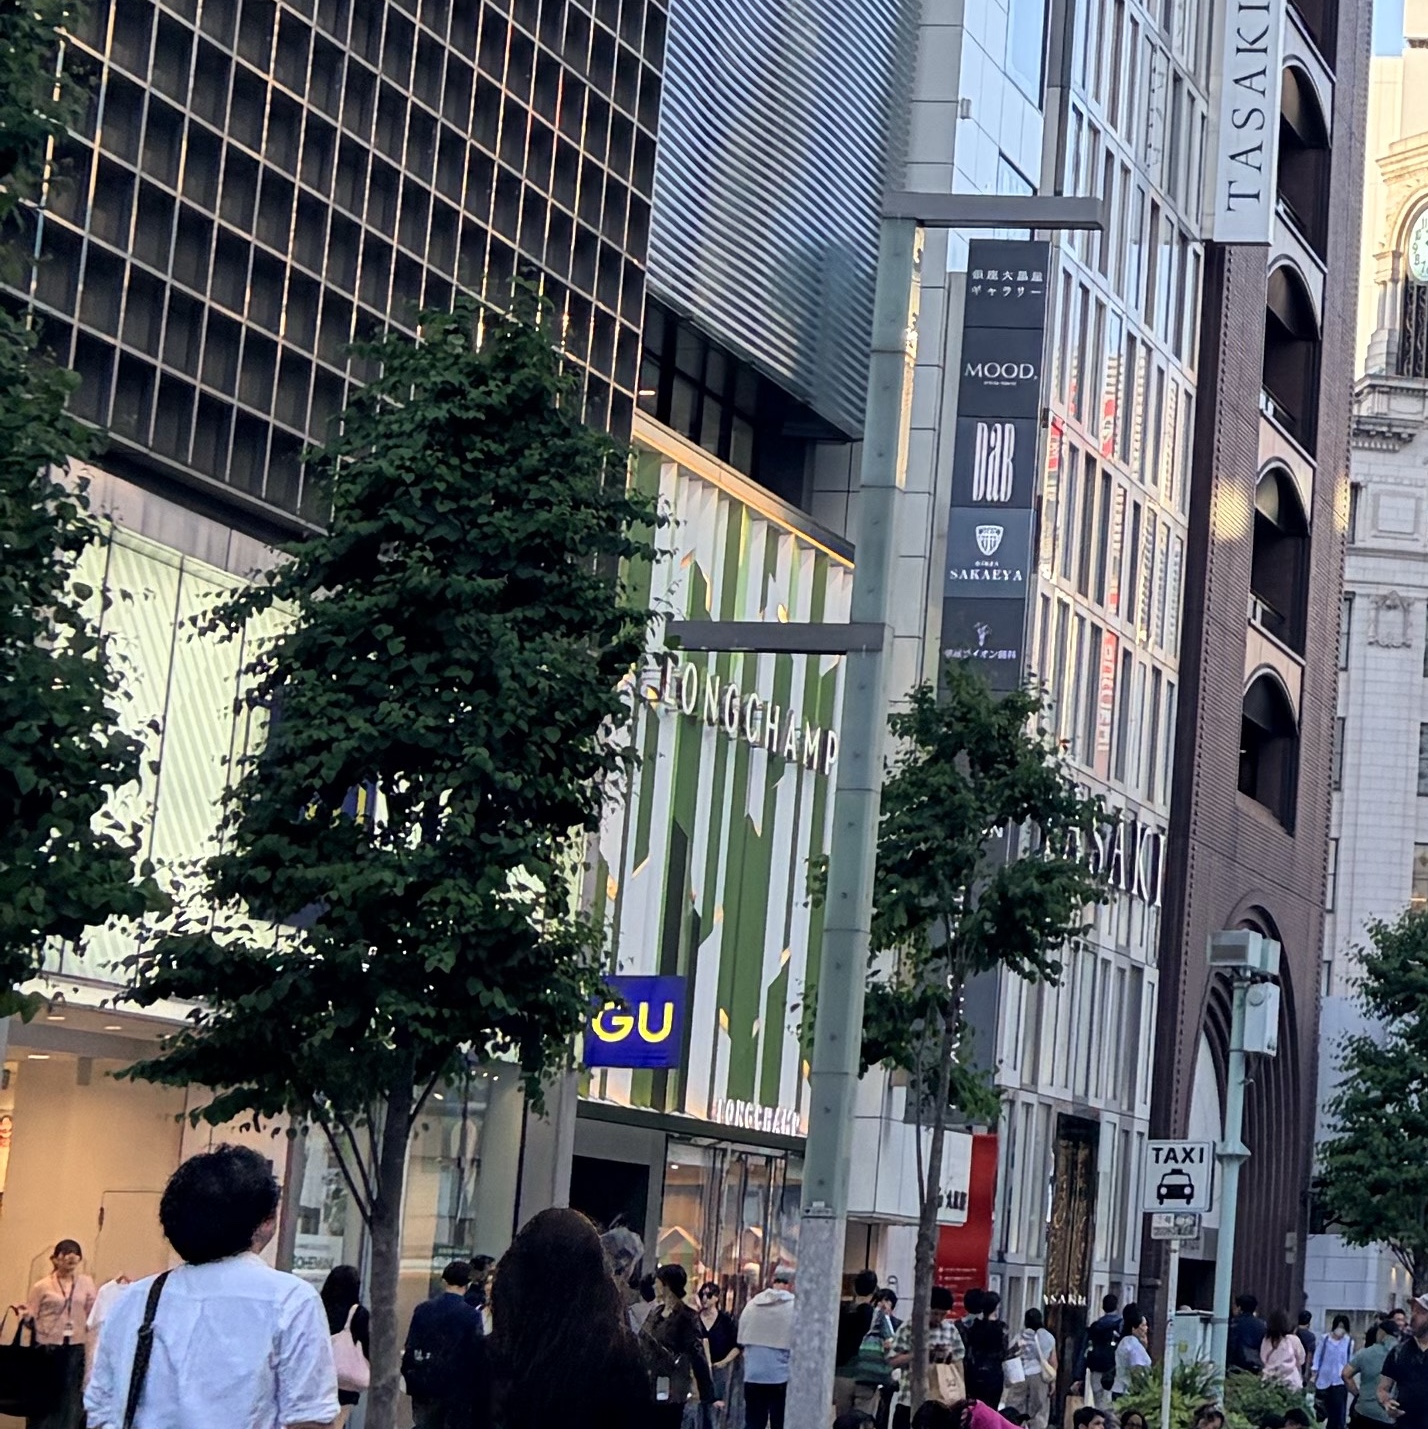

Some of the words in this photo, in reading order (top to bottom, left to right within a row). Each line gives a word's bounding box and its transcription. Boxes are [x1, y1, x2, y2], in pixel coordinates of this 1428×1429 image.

[1225, 1, 1271, 212] TASAKI
[949, 568, 1023, 582] SAKAEYA
[664, 655, 839, 775] LONGCHAMP
[591, 1001, 674, 1043] GU
[1151, 1147, 1204, 1164] TAXI
